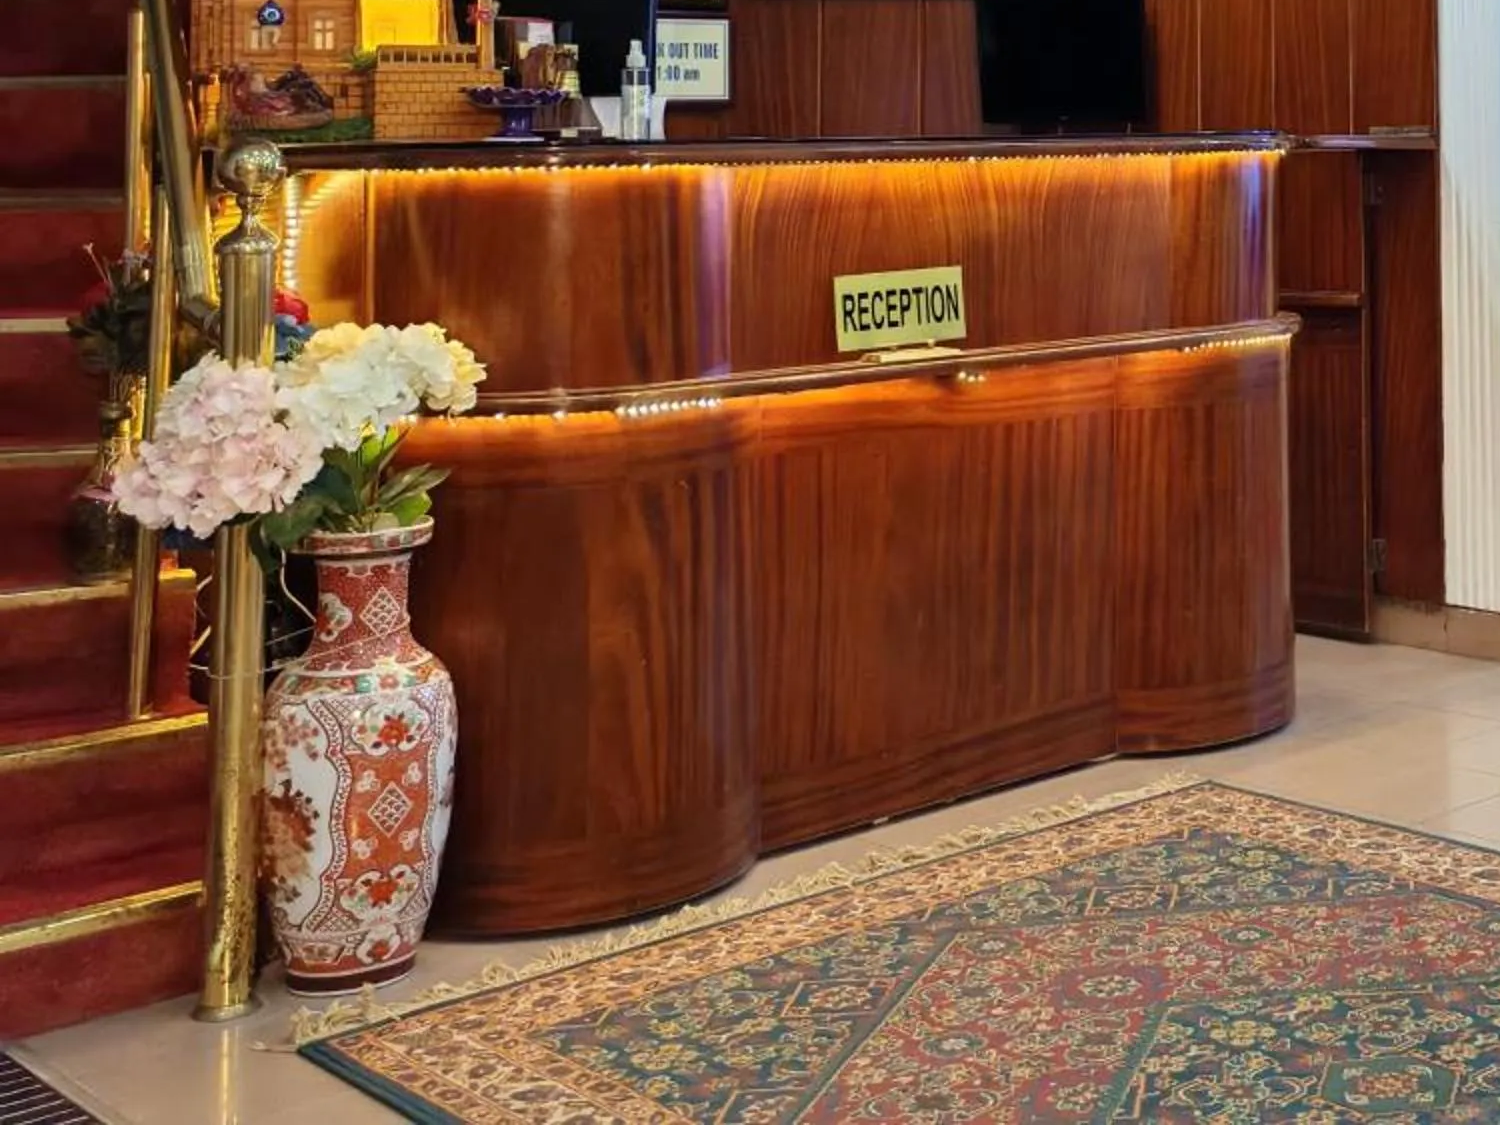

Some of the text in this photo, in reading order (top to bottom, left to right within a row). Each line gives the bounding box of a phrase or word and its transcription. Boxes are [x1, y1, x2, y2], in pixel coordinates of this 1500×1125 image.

[667, 42, 690, 60] OUT
[693, 42, 719, 60] TIME
[841, 283, 960, 333] RECEPTION
